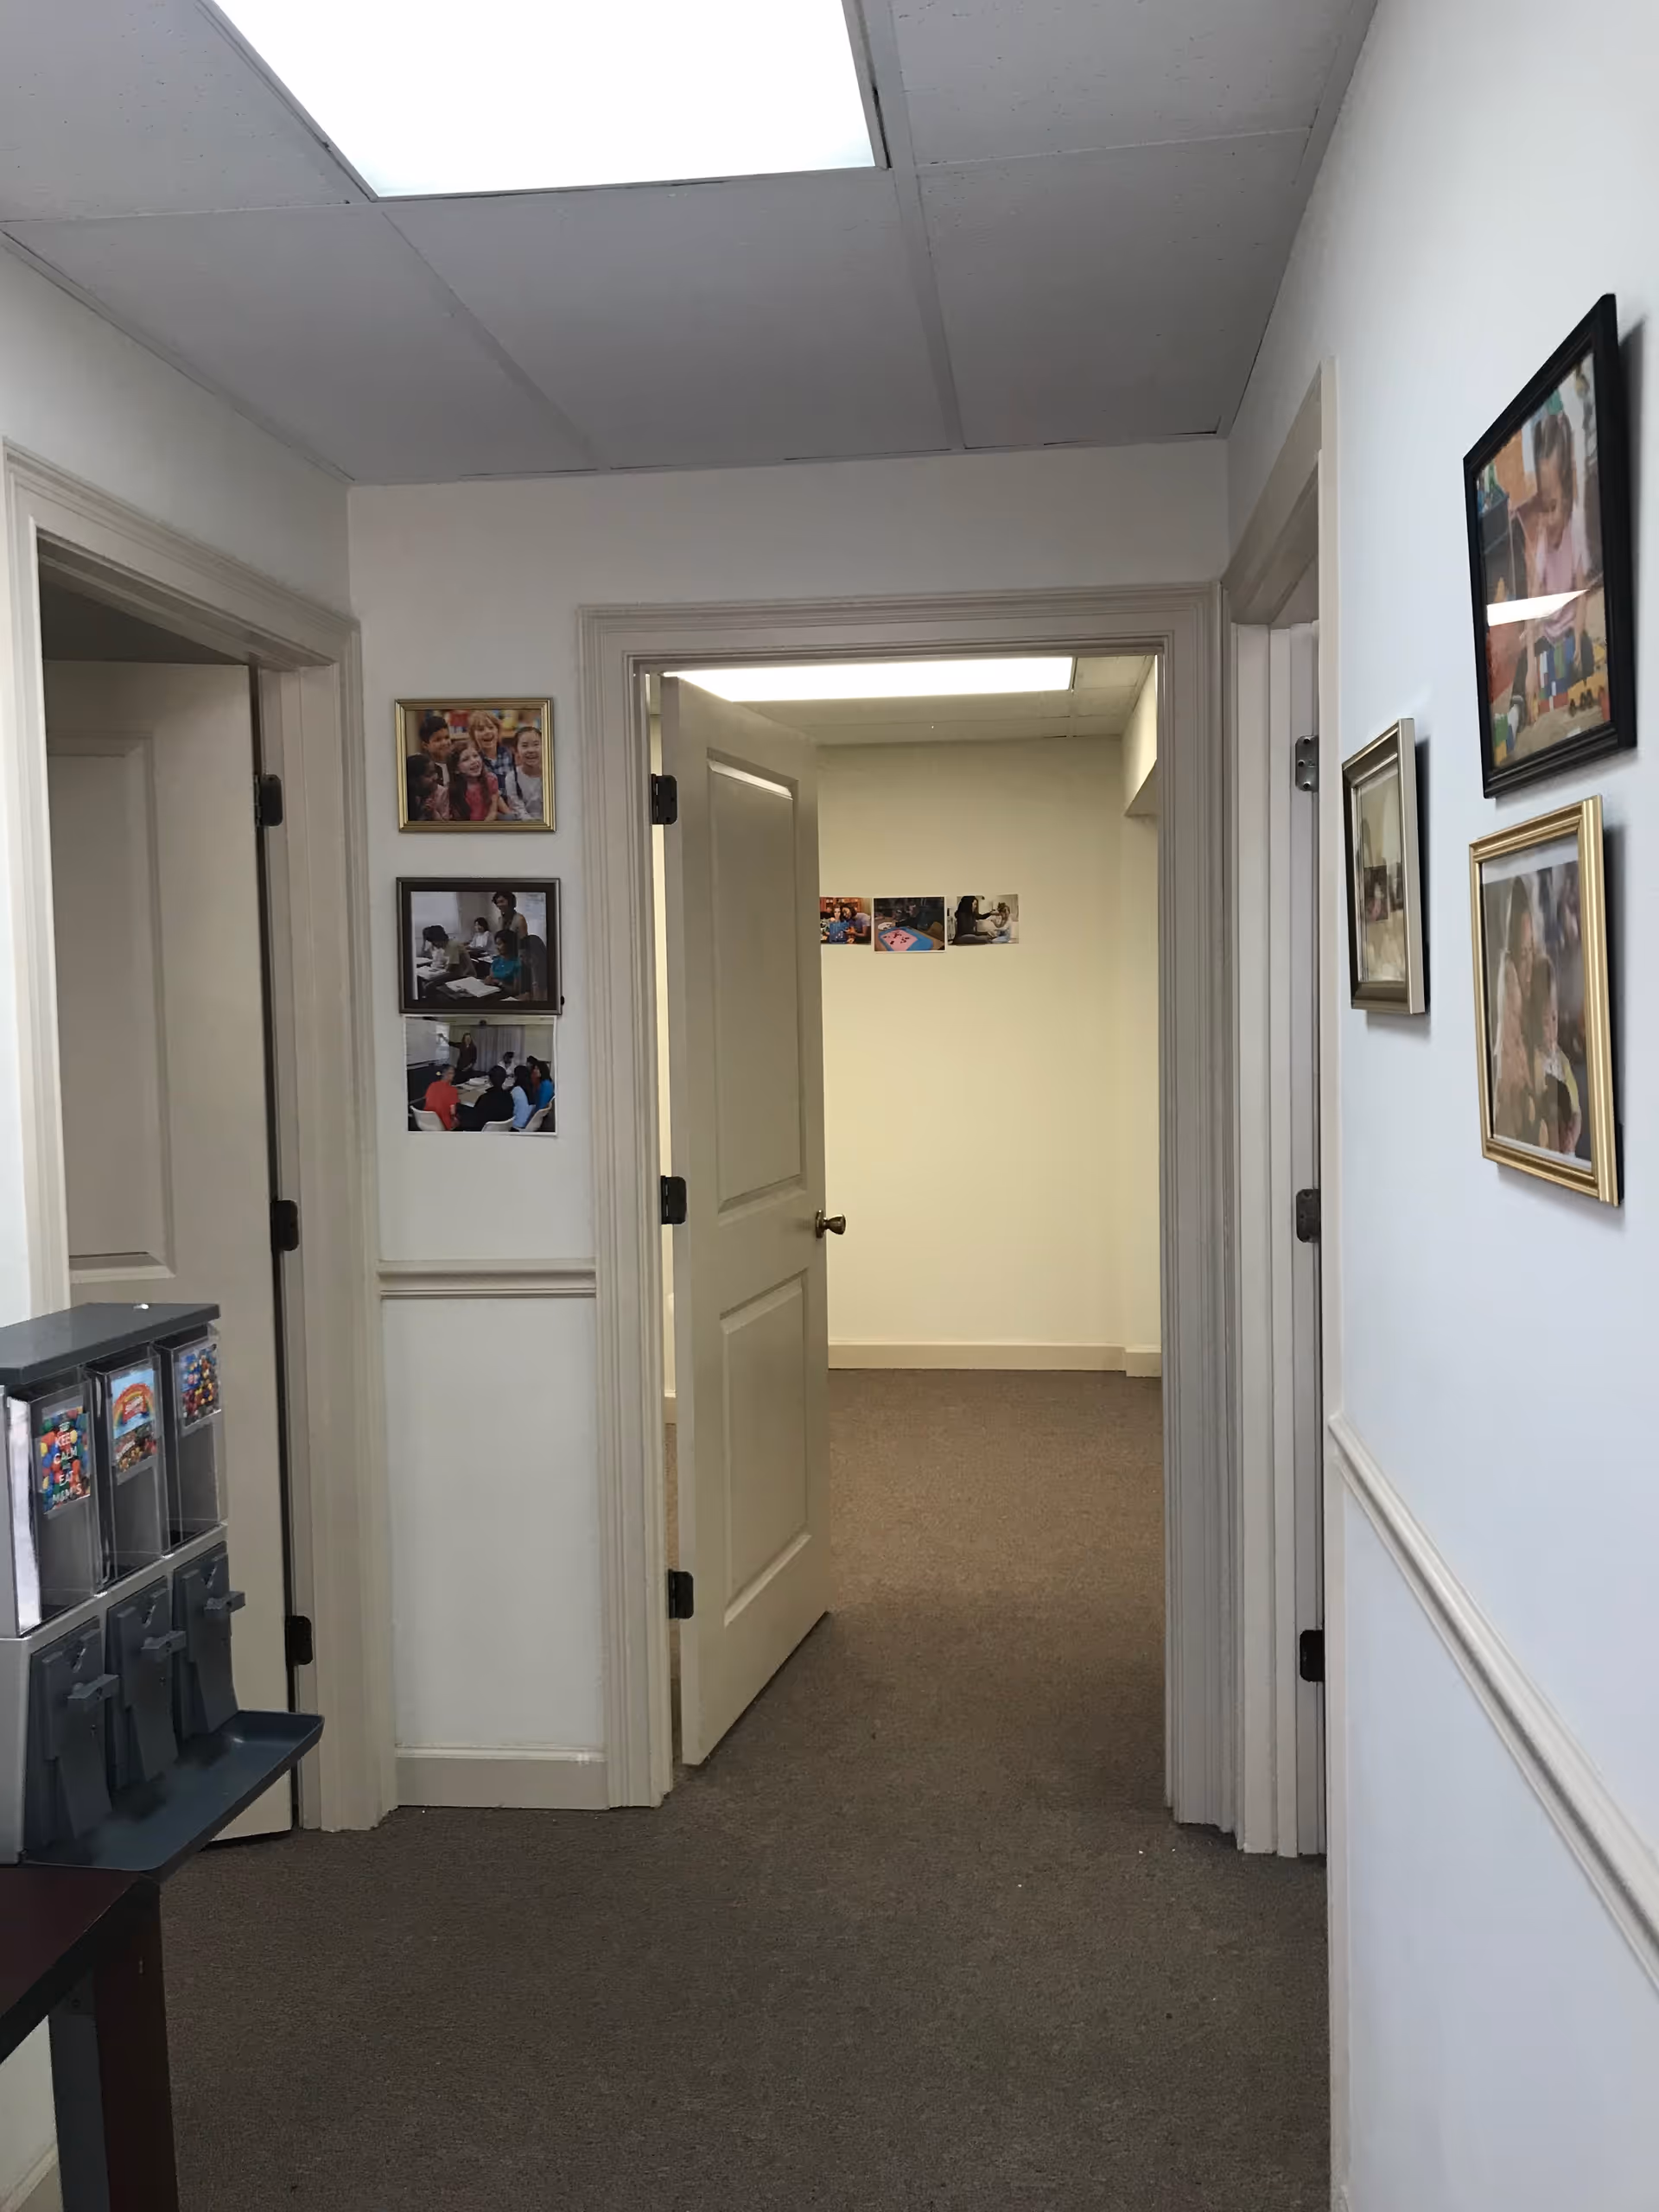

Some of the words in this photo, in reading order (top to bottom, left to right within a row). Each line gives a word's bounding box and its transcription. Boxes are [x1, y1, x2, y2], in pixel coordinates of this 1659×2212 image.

[55, 1432, 76, 1447] KEE
[54, 1446, 78, 1465] CALM
[59, 1470, 74, 1486] EAT
